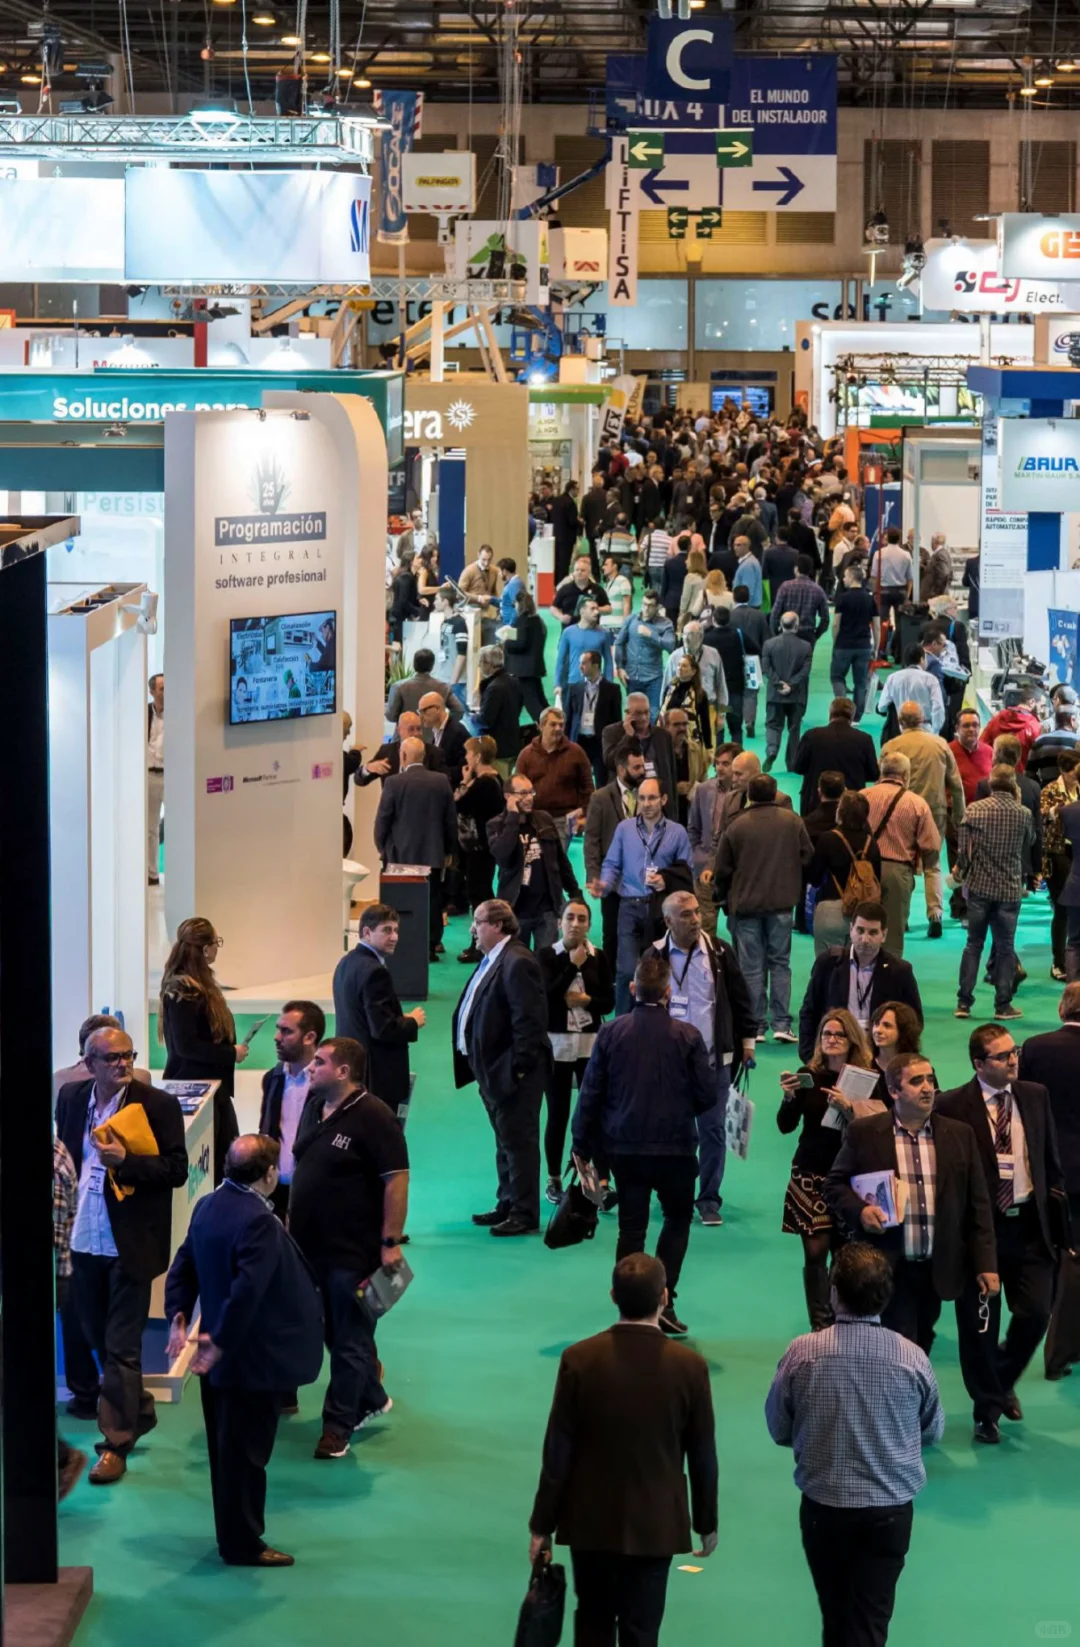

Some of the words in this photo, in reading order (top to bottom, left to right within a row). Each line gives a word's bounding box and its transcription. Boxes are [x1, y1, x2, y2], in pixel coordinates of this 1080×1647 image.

[664, 29, 714, 90] C
[750, 89, 764, 104] EL
[767, 89, 809, 104] MUNDO
[731, 109, 754, 124] DEL
[756, 109, 828, 124] INSTALADOR
[1025, 291, 1064, 304] Elect.
[53, 397, 187, 419] Soluciones
[1023, 456, 1079, 471] BAUR
[262, 481, 275, 498] 25
[219, 514, 323, 542] Programación
[220, 548, 322, 565] INTEGRAL
[215, 574, 264, 590] software
[266, 568, 326, 588] profesional
